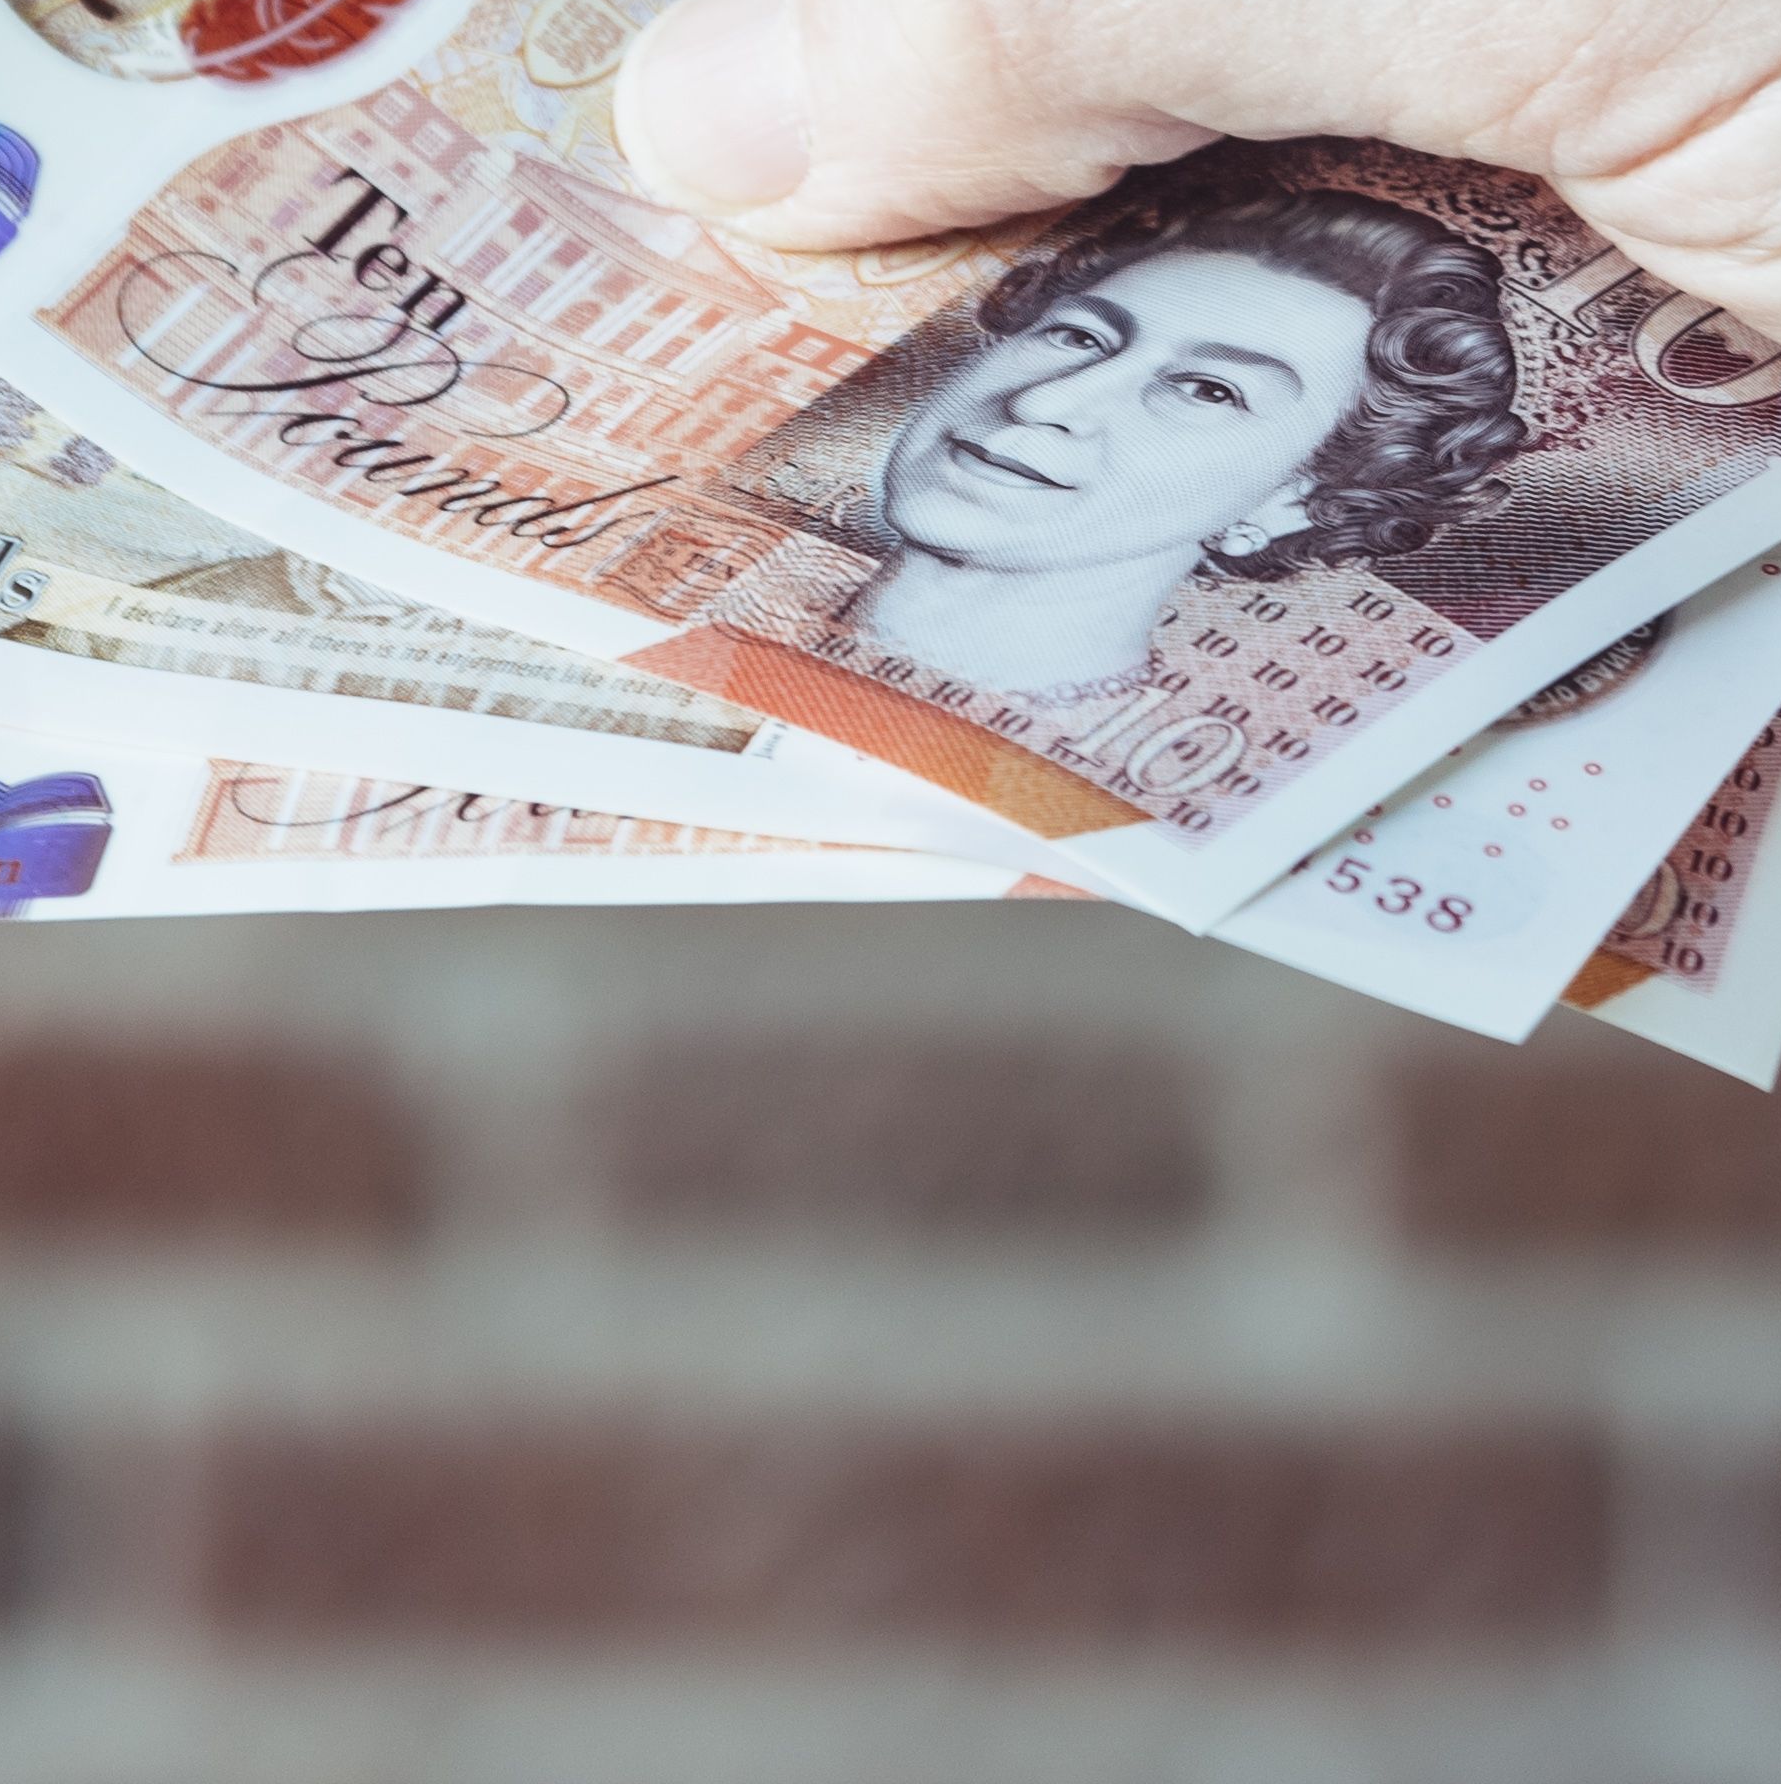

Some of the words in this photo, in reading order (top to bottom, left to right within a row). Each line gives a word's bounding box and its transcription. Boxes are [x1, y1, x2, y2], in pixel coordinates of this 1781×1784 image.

[304, 165, 468, 335] Ten
[118, 250, 679, 549] Pounds
[1239, 592, 1289, 625] 10
[1299, 624, 1348, 657] 10
[1357, 660, 1408, 694] 10
[1345, 590, 1396, 623] 10
[1406, 625, 1457, 659] 10
[1190, 627, 1240, 660] 10
[1250, 660, 1300, 694] 10
[1308, 694, 1358, 728] 10
[930, 678, 975, 710] 10
[988, 705, 1034, 737] 10
[1167, 799, 1214, 833] 10
[1044, 685, 1248, 798] 10
[1261, 729, 1311, 763] 10
[1689, 847, 1735, 884] 10
[1701, 803, 1748, 839] 10
[1659, 938, 1706, 976] 10
